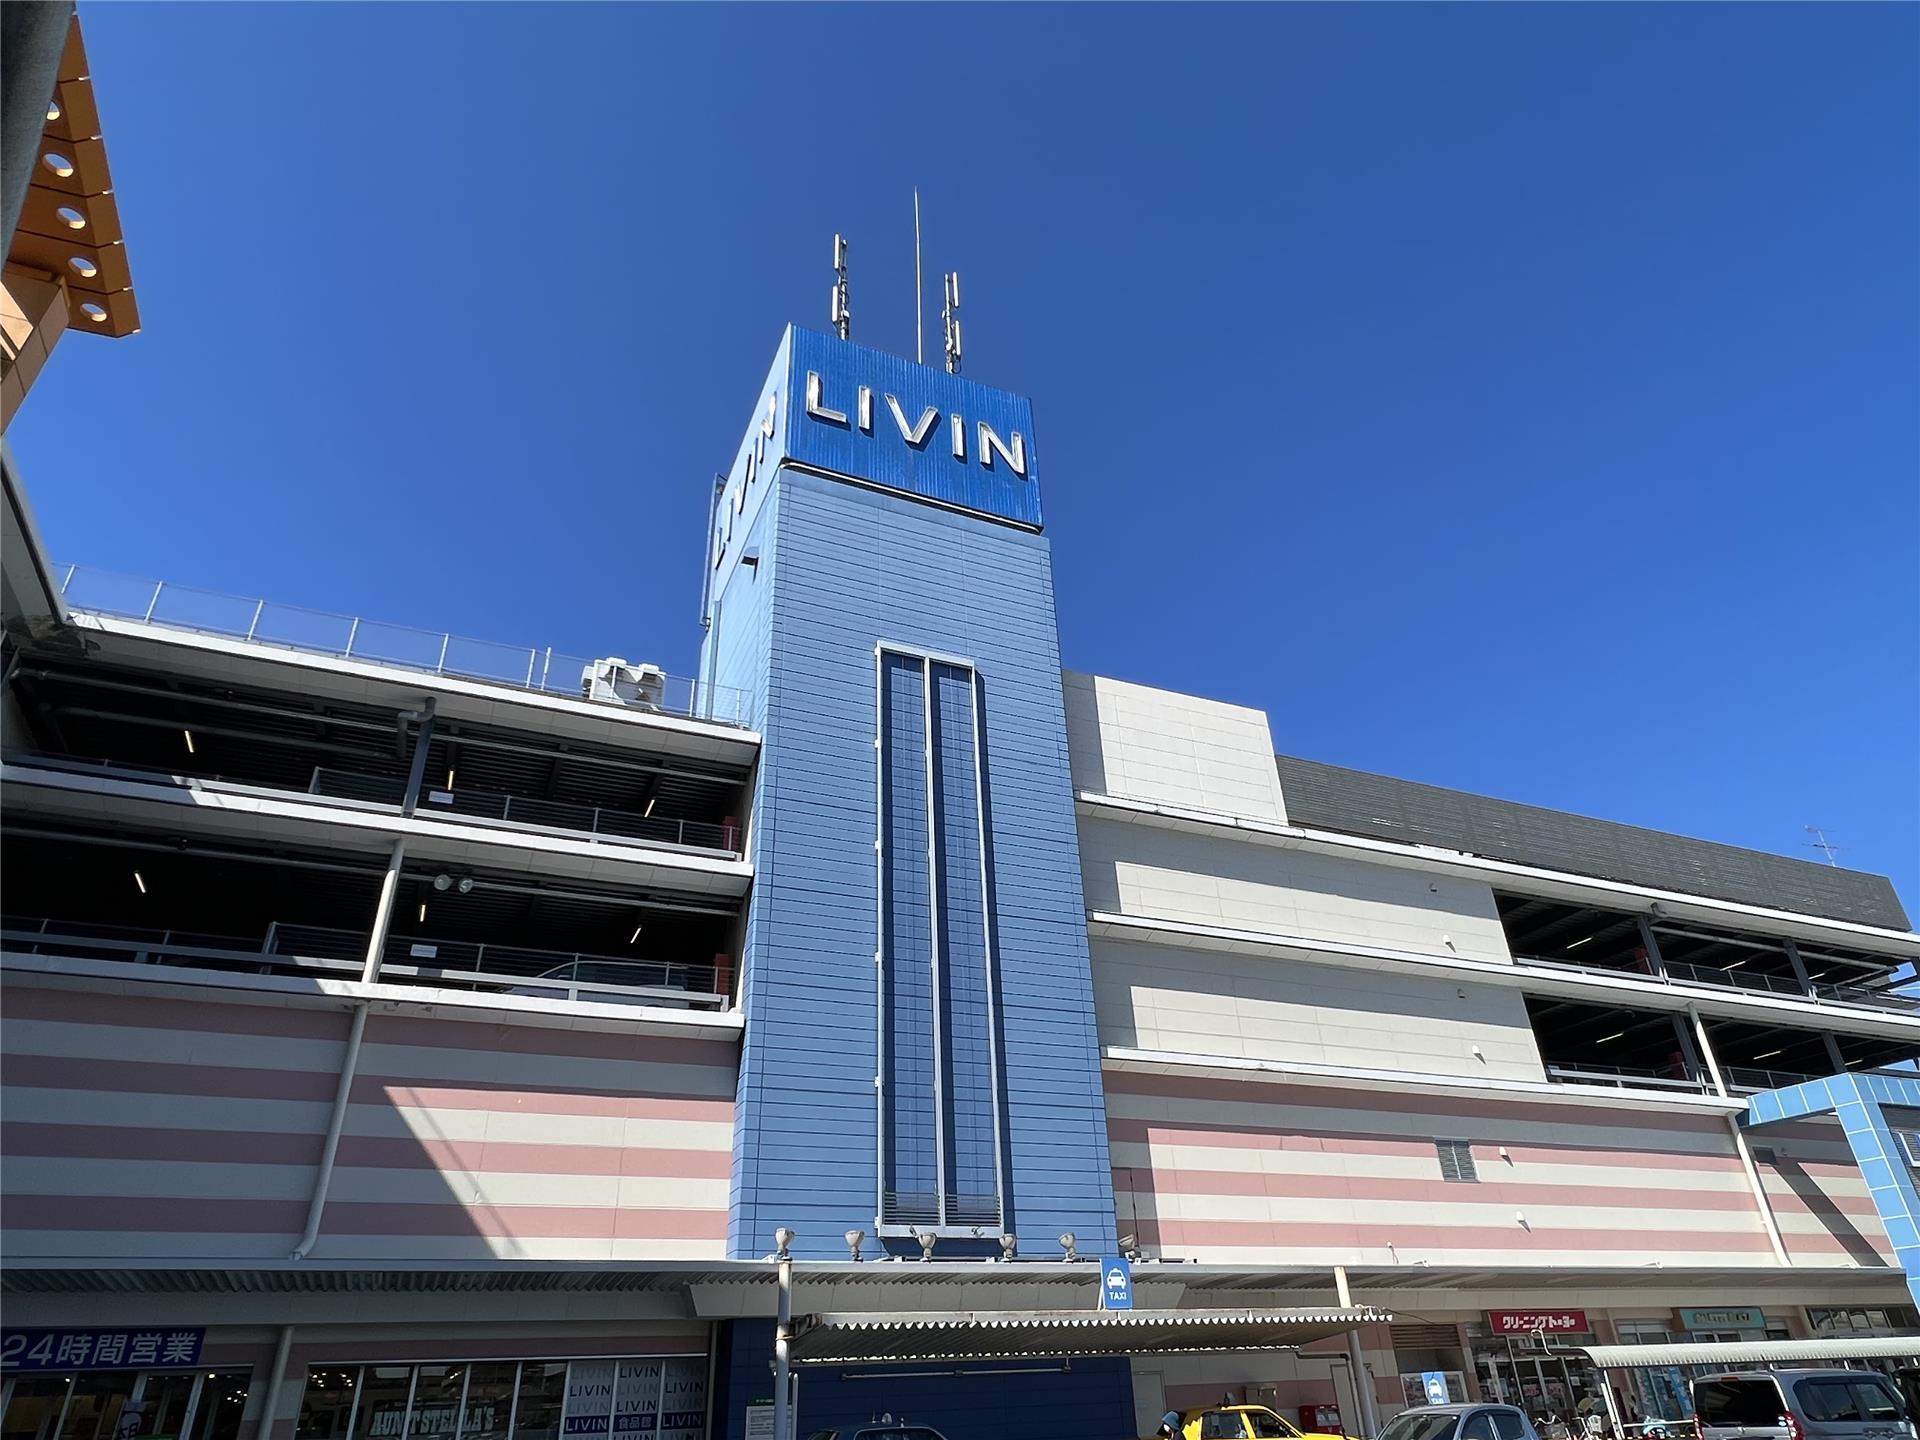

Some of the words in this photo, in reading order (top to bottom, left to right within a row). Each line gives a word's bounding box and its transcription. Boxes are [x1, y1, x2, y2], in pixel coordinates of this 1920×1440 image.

[806, 369, 1025, 475] LIVIN
[1109, 1291, 1127, 1301] TAXI
[1, 1332, 198, 1367] 24時間営業
[619, 1367, 660, 1378] LIVIN
[569, 1384, 611, 1397] LIVIN
[665, 1381, 704, 1394] LIVIN
[616, 1399, 657, 1412] LIVIN
[565, 1418, 608, 1431] LIVIN
[618, 1417, 652, 1429] 食品館
[662, 1414, 702, 1427] LIVIN
